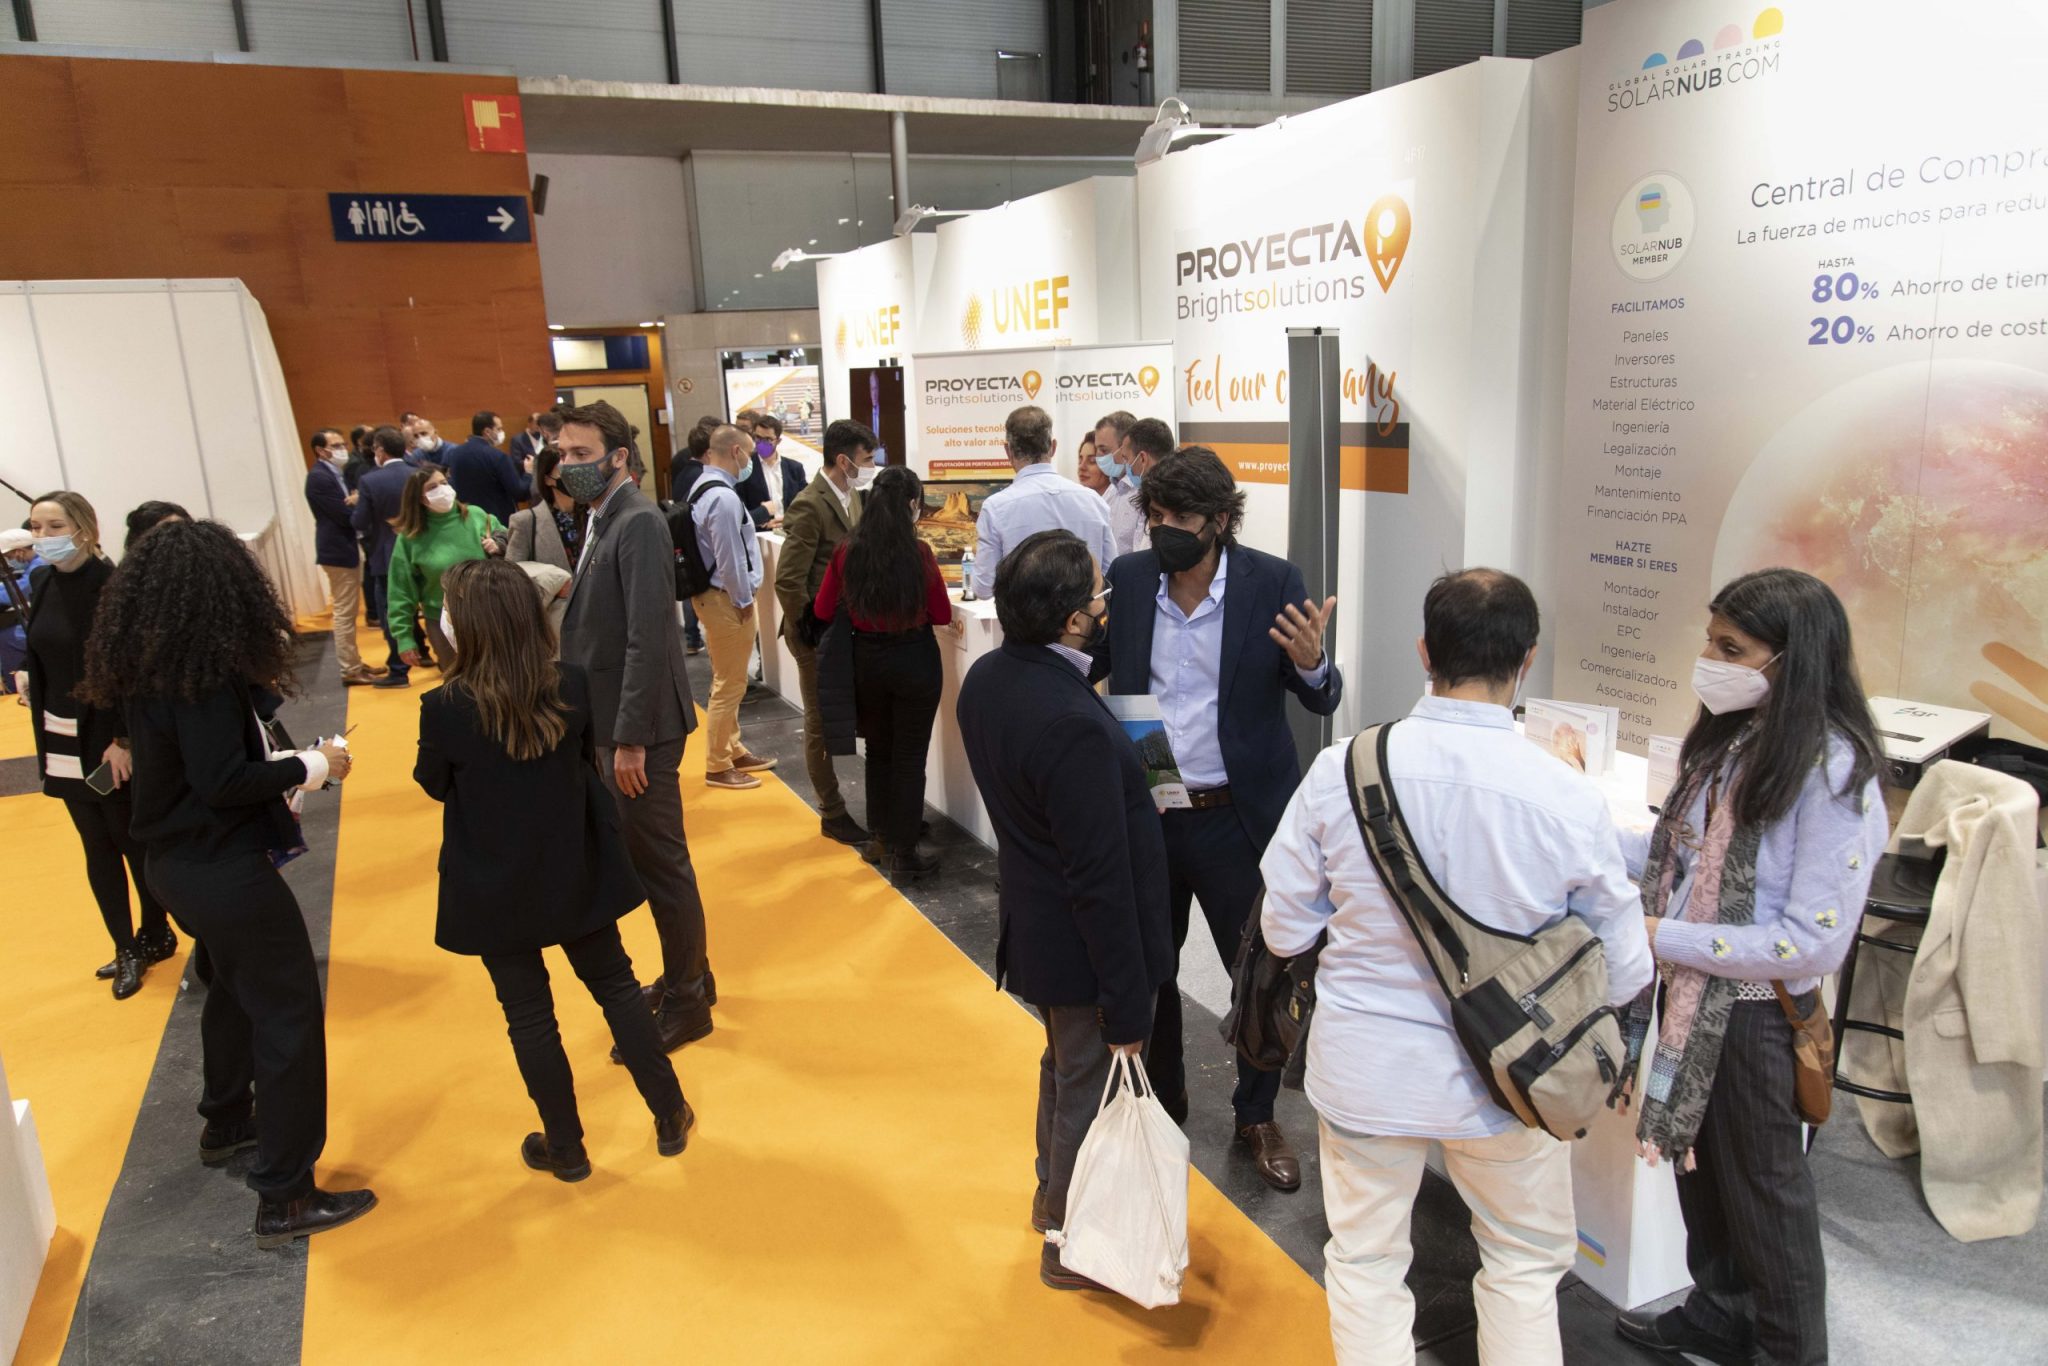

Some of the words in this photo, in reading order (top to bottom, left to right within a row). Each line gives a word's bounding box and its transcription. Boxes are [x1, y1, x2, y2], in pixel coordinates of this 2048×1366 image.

[1609, 73, 1656, 91] GLOBAL
[1665, 59, 1707, 76] SOLAR
[1717, 40, 1781, 63] TRADING
[1607, 52, 1780, 113] SOLARNUB.COM
[1750, 168, 1854, 208] Central
[1866, 163, 1905, 192] de
[1737, 229, 1757, 245] La
[1763, 224, 1817, 243] fuerza
[1823, 217, 1847, 234] de
[1853, 208, 1931, 231] muchos
[1937, 203, 1987, 224] para
[1176, 219, 1361, 286] PROYECTA
[1620, 237, 1683, 256] SOLARNUB
[1632, 253, 1669, 265] MEMBER
[1818, 257, 1855, 270] HASTA
[1811, 272, 1879, 303] 80%
[1891, 278, 1963, 297] Ahorro
[1971, 272, 1998, 291] de
[992, 275, 1069, 334] UNEF
[1177, 275, 1365, 322] Brightsolutions
[1611, 298, 1685, 314] FACILITAMOS
[853, 305, 900, 348] UNEF
[1808, 315, 1875, 345] 20%
[1886, 324, 1959, 342] Ahorro
[1966, 320, 1993, 338] de
[2000, 317, 2048, 337] cost
[1623, 330, 1669, 343] Paneles
[1614, 353, 1676, 366] Inversores
[925, 376, 1022, 393] PROYECTA
[1055, 372, 1137, 389] OYECTA
[1184, 354, 1223, 412] Feel
[1229, 370, 1267, 402] our
[1610, 376, 1678, 389] Estructuras
[925, 390, 1024, 407] Brightsolutions
[1592, 398, 1637, 411] Material
[1640, 398, 1695, 411] Eléctrico
[926, 424, 973, 434] Soluciones
[1612, 420, 1670, 435] Ingeniería
[944, 437, 962, 447] alto
[964, 436, 986, 447] valor
[1603, 443, 1676, 457] Legalización
[1614, 464, 1662, 479] Montaje
[1594, 485, 1681, 502] Mantenimiento
[1587, 505, 1658, 523] Financiación
[1662, 511, 1687, 525] PPA
[1615, 540, 1652, 553] HAZTE
[1590, 553, 1634, 567] MEMBER
[1636, 558, 1646, 569] SI
[1649, 560, 1678, 573] ERES
[1604, 581, 1660, 600] Montador
[1602, 602, 1659, 621] Instalador
[1617, 625, 1641, 640] EPC
[1601, 643, 1656, 664] Ingeniería
[1580, 658, 1678, 690] Comercializadora
[1596, 682, 1657, 707] Asociación
